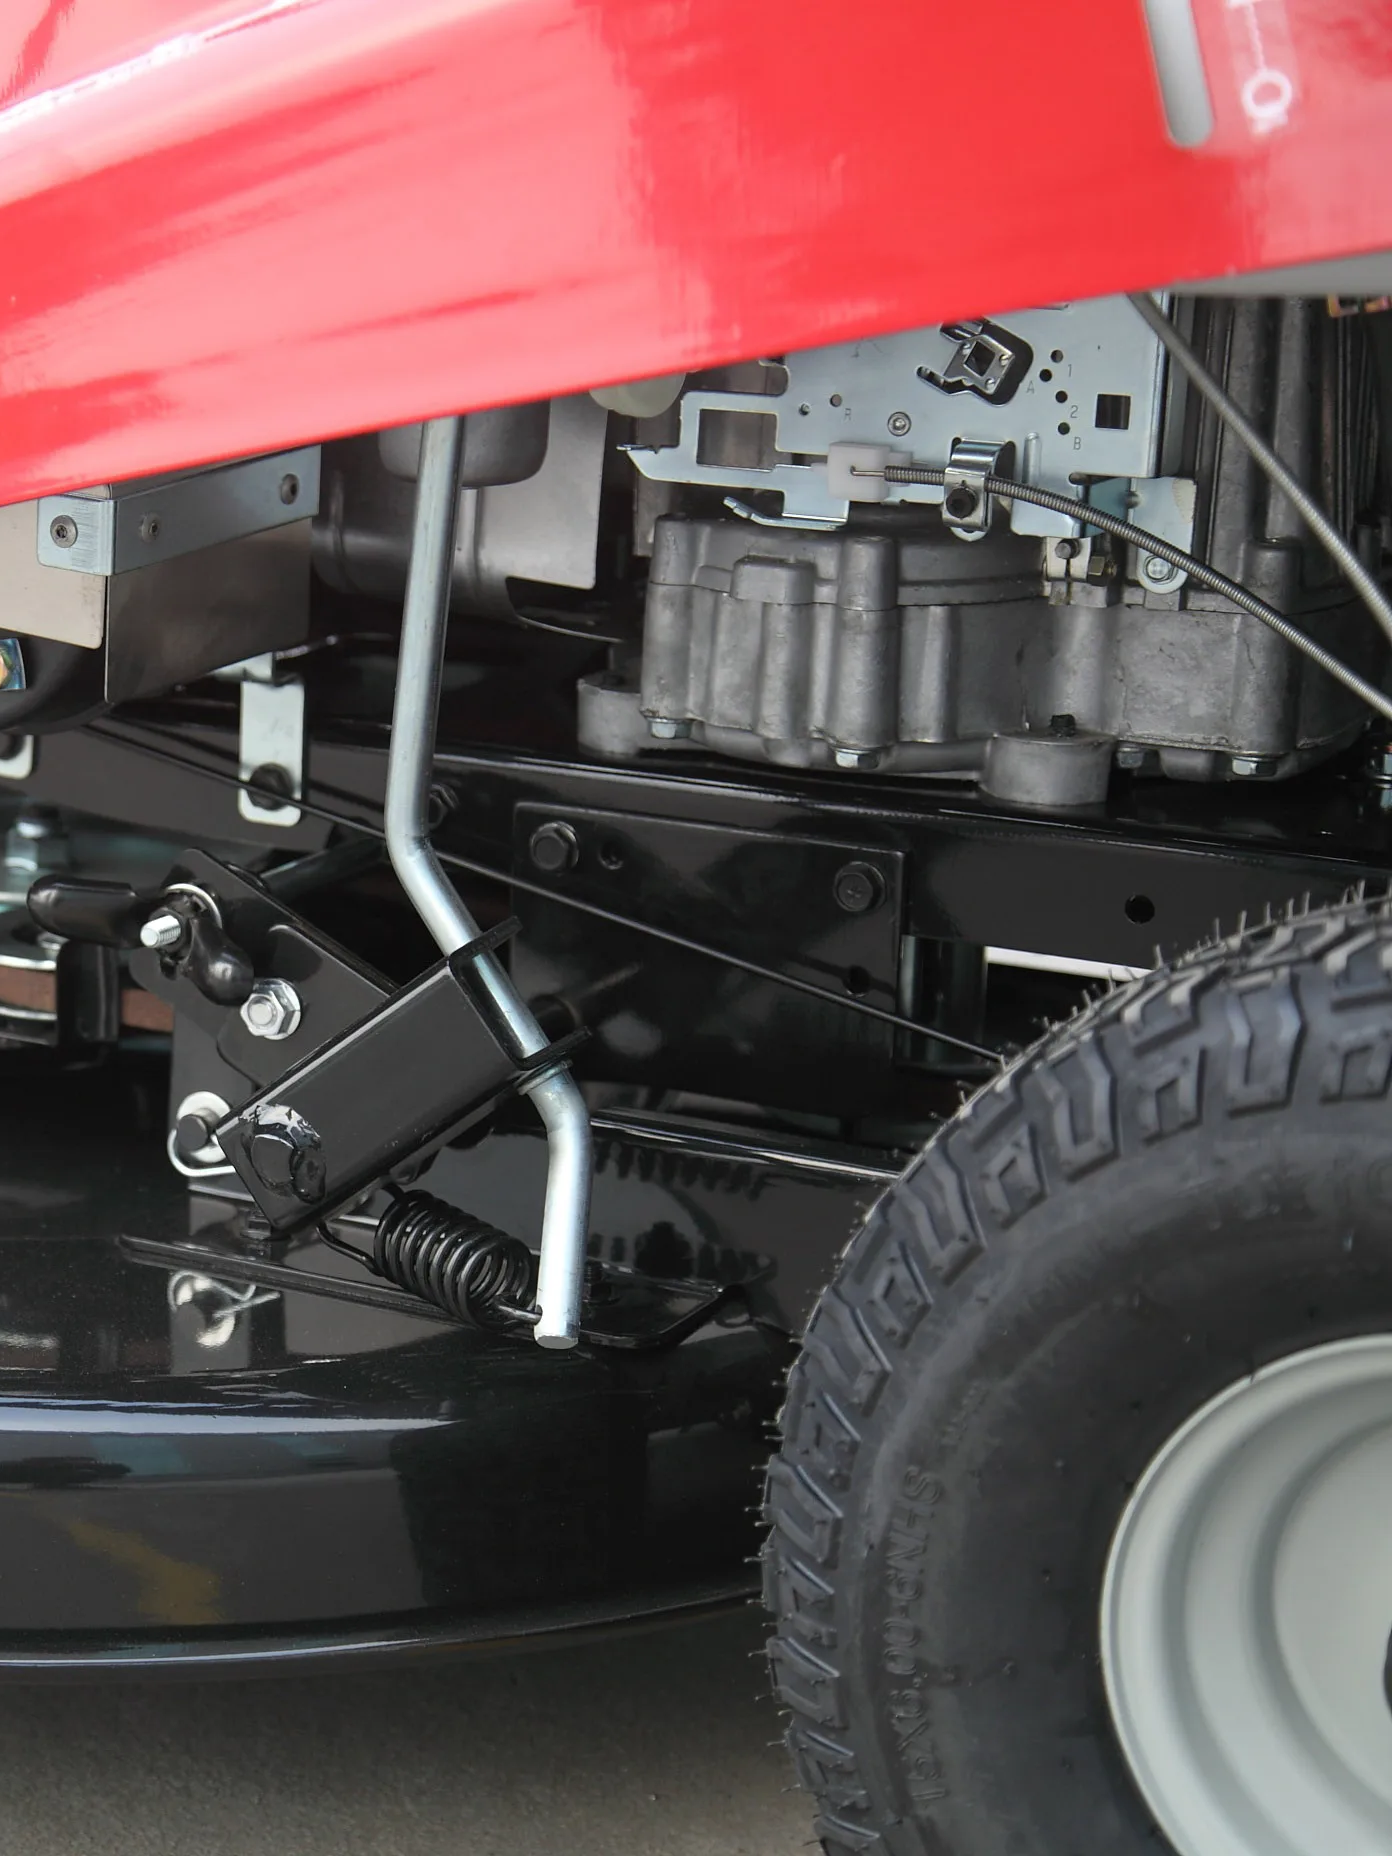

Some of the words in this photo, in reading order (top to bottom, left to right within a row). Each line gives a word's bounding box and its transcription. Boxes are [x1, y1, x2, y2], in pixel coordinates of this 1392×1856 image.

[1067, 363, 1073, 378] 1
[1025, 380, 1035, 394] A
[843, 407, 852, 421] R
[1069, 404, 1079, 419] 2
[1072, 436, 1081, 450] B
